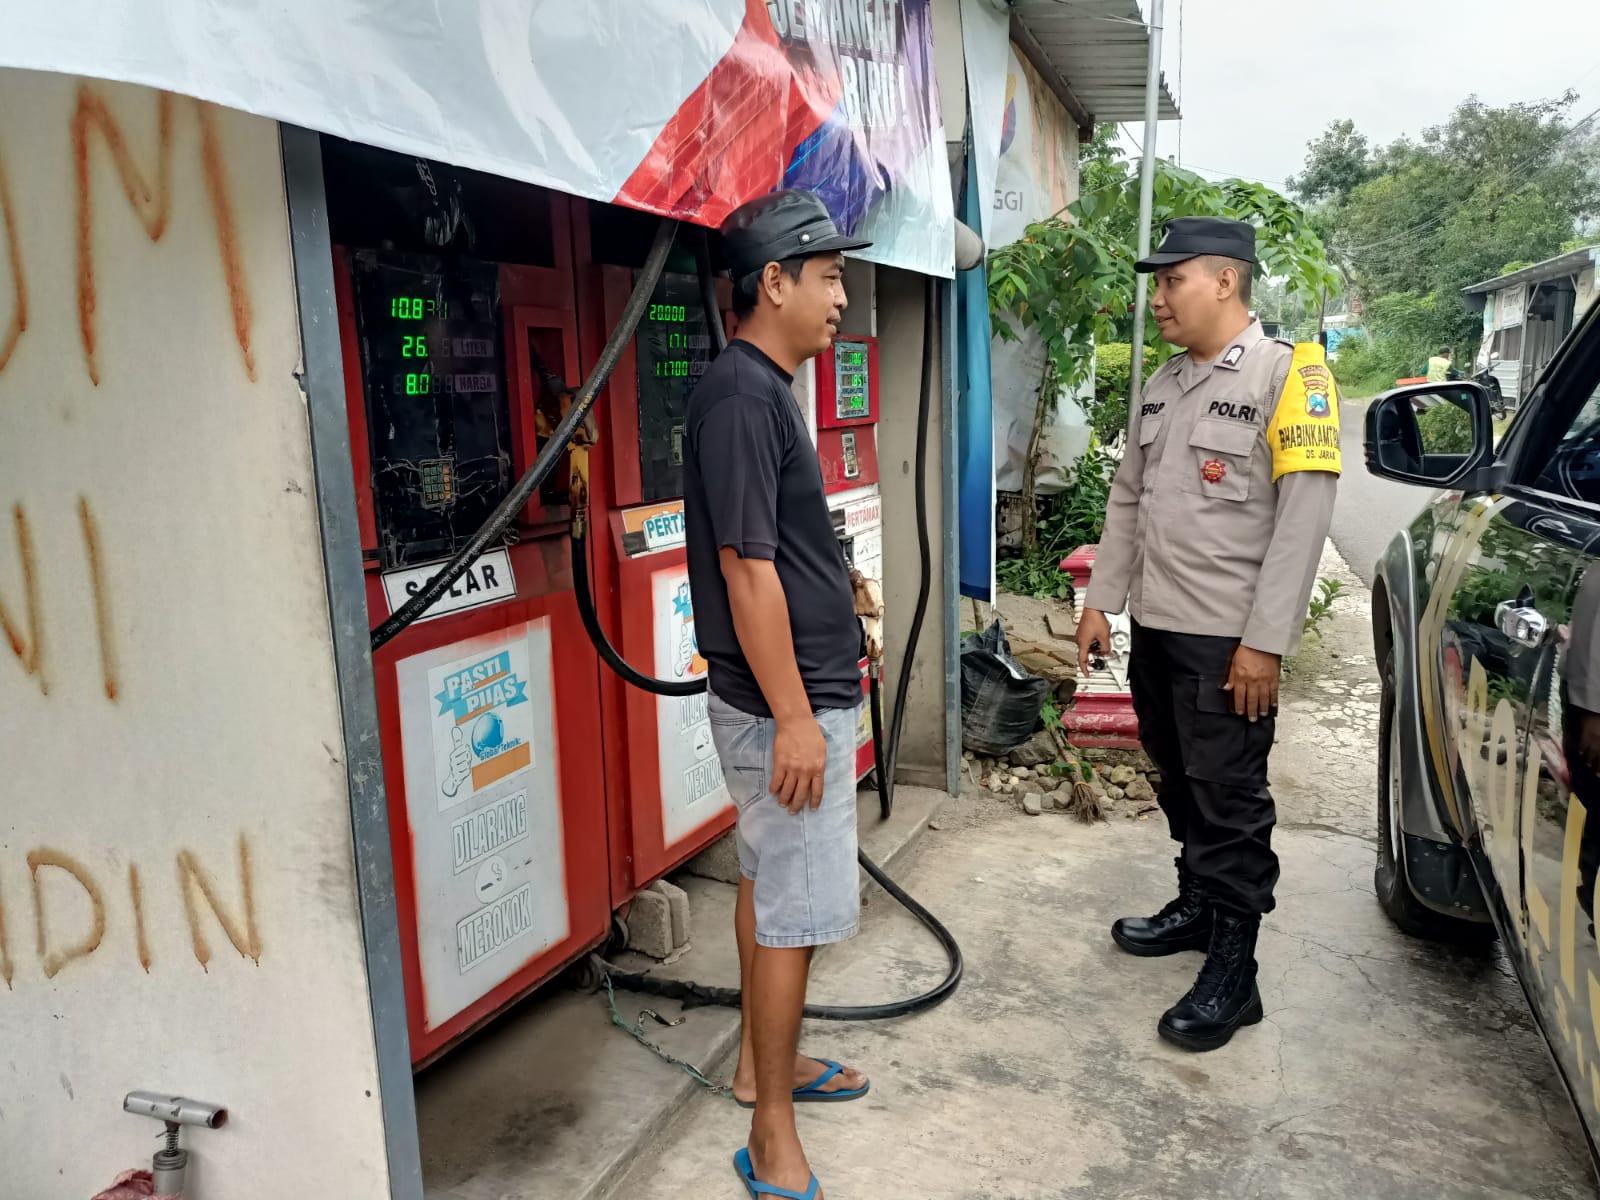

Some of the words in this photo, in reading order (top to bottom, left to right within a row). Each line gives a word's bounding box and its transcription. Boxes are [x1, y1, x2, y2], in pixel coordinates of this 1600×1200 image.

[1208, 401, 1257, 422] POLRI
[847, 504, 881, 529] PERTAMAX
[446, 658, 502, 699] PASTI
[453, 795, 528, 868] DILARANG
[0, 830, 260, 988] DIN
[458, 888, 532, 967] MEROKOK
